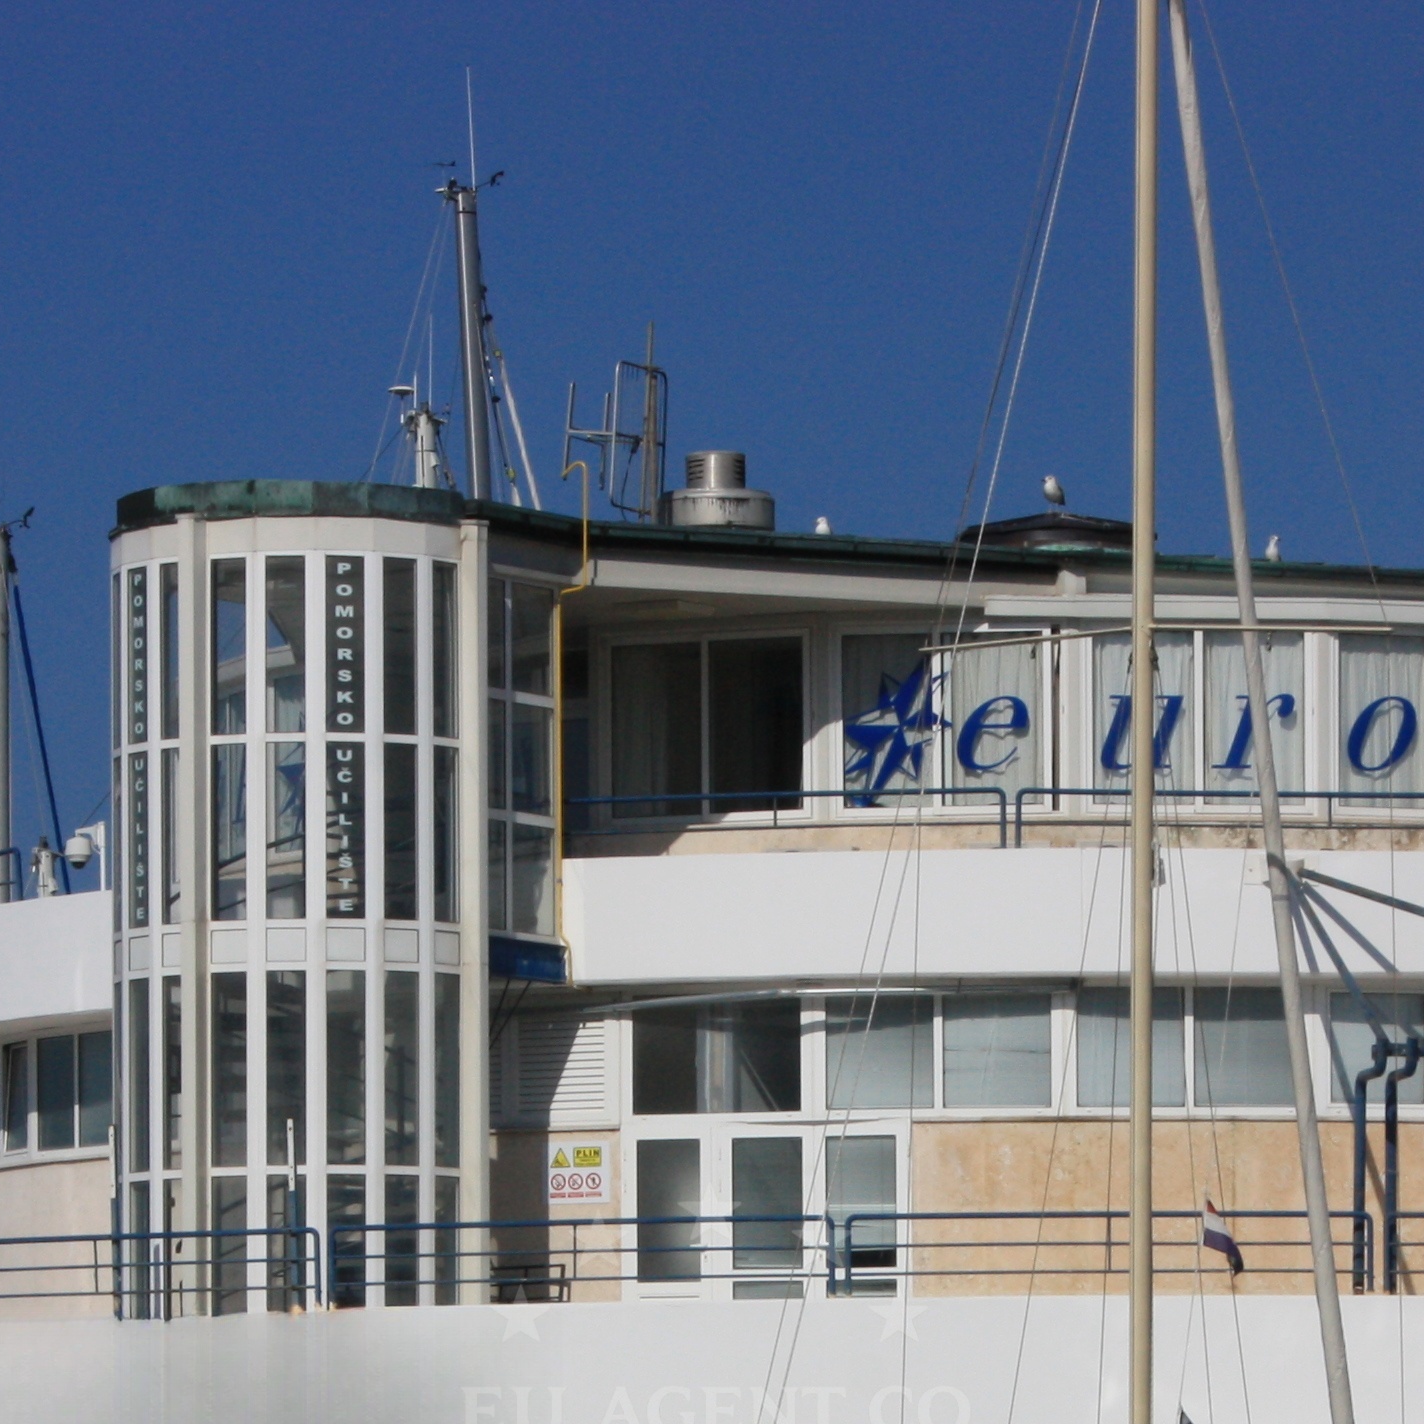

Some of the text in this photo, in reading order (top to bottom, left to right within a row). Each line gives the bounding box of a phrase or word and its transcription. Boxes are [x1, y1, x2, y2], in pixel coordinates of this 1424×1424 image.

[133, 575, 146, 920] POMORSKO UČILIŠTE
[335, 562, 354, 912] POMORSKO UČILIŠTE
